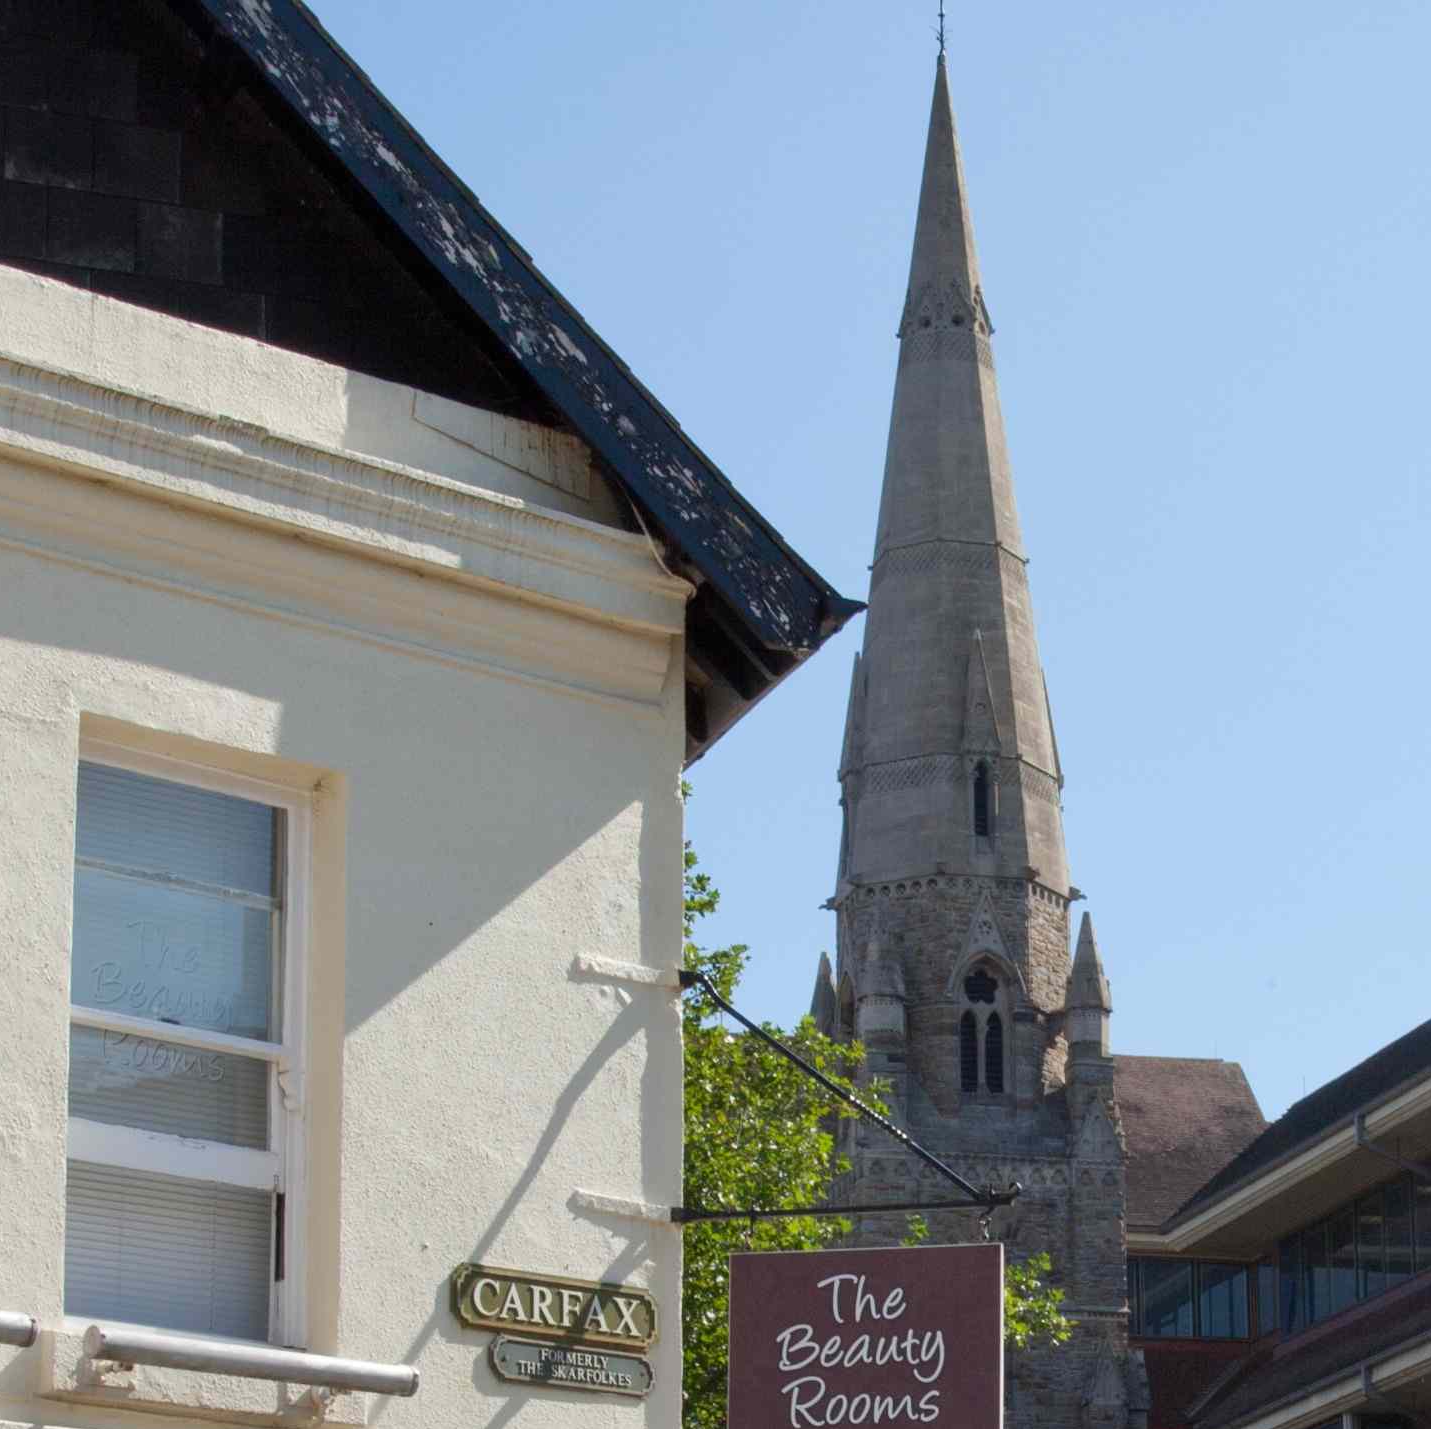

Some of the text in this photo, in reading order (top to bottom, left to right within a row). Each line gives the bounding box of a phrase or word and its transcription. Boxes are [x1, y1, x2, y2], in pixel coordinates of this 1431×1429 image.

[473, 1278, 642, 1338] CARFAX
[817, 1273, 906, 1324] The
[519, 1360, 632, 1386] THE SKARFOLKES
[541, 1349, 609, 1369] FORMERLY
[776, 1324, 945, 1383] Beauty
[781, 1376, 940, 1429] Rooms
